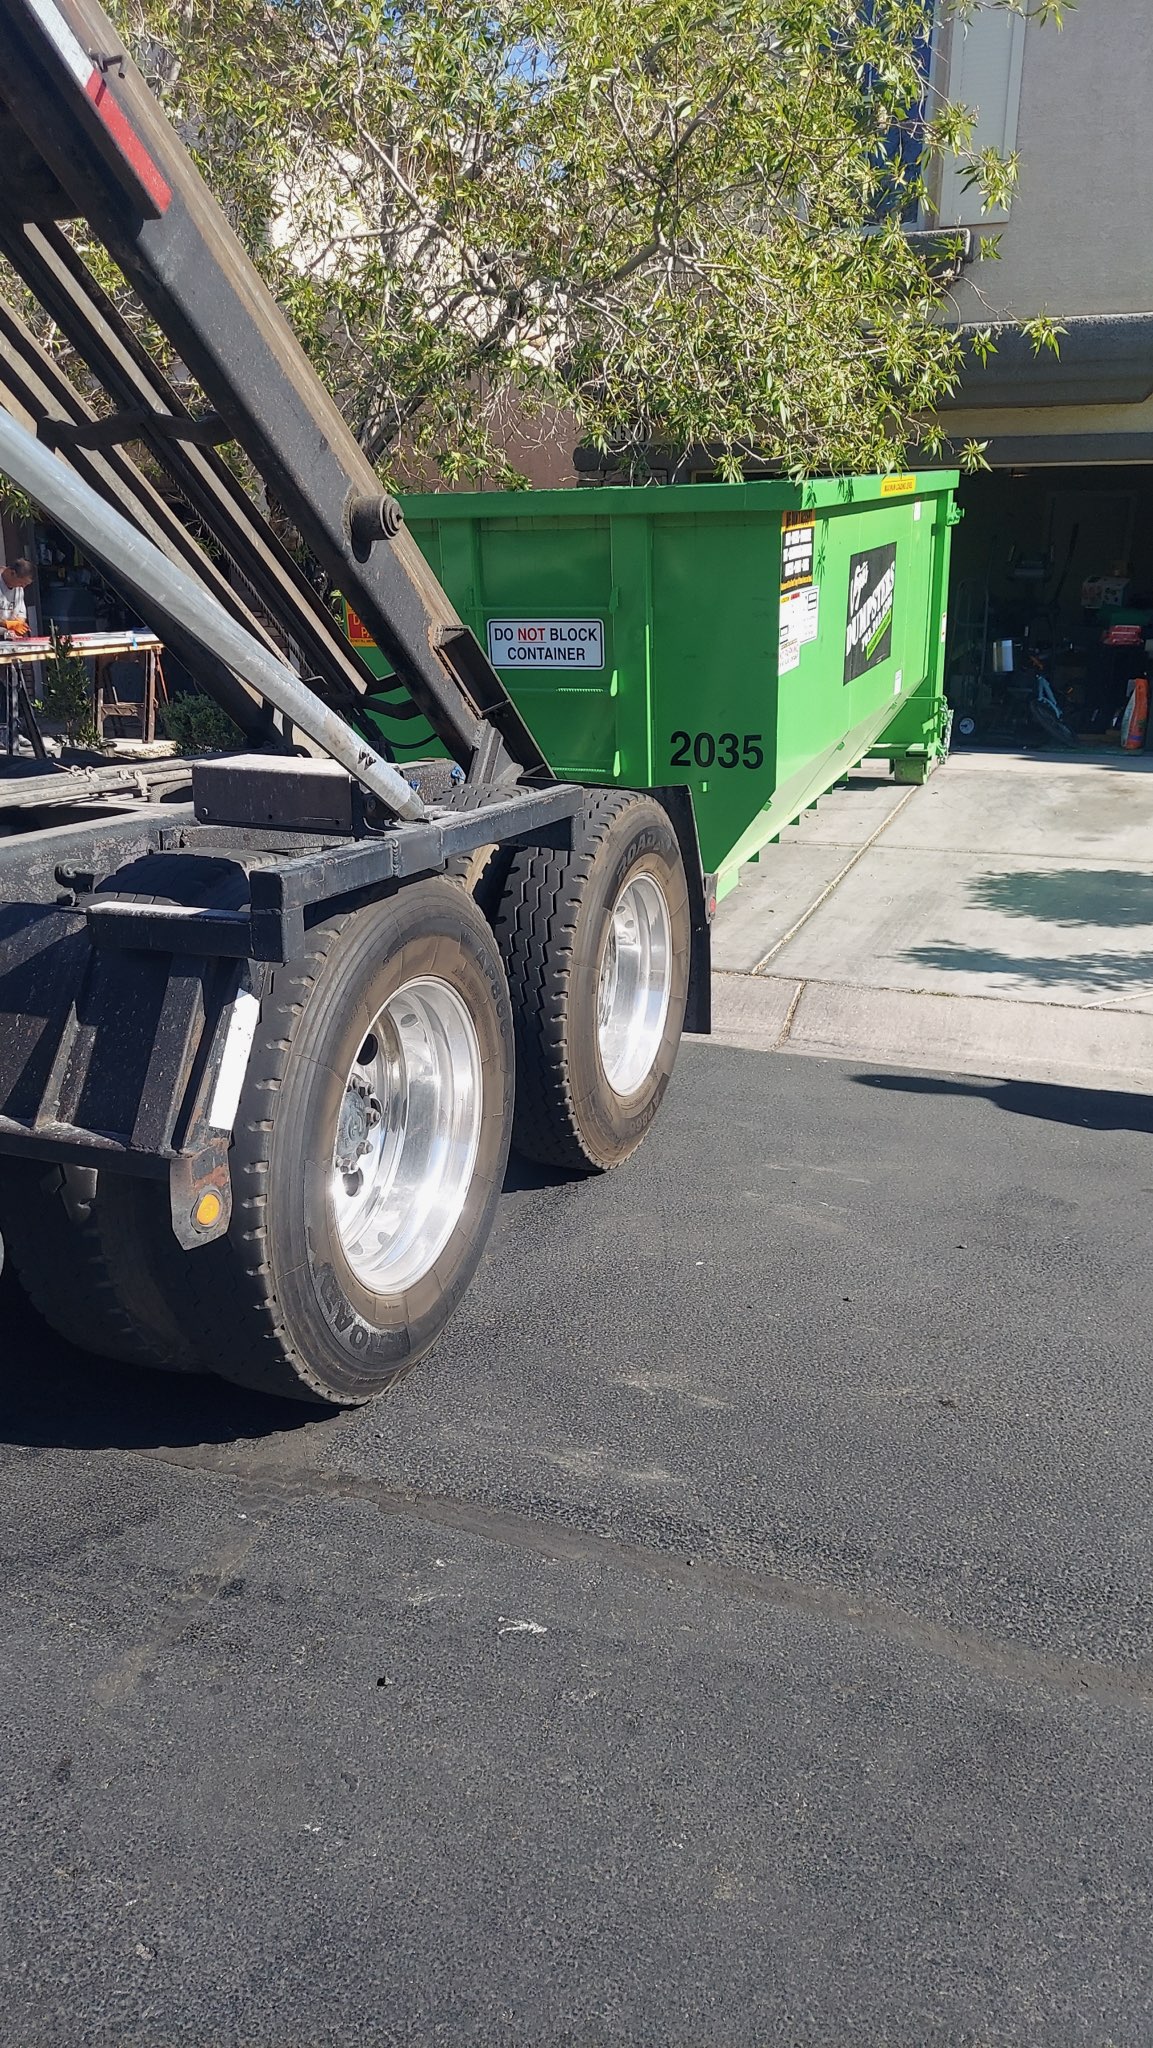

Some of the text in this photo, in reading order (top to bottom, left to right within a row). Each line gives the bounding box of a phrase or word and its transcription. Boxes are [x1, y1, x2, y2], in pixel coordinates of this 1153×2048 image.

[494, 628, 598, 641] DO NOT BLOCK
[507, 646, 585, 661] CONTAINER
[670, 730, 764, 769] 2035
